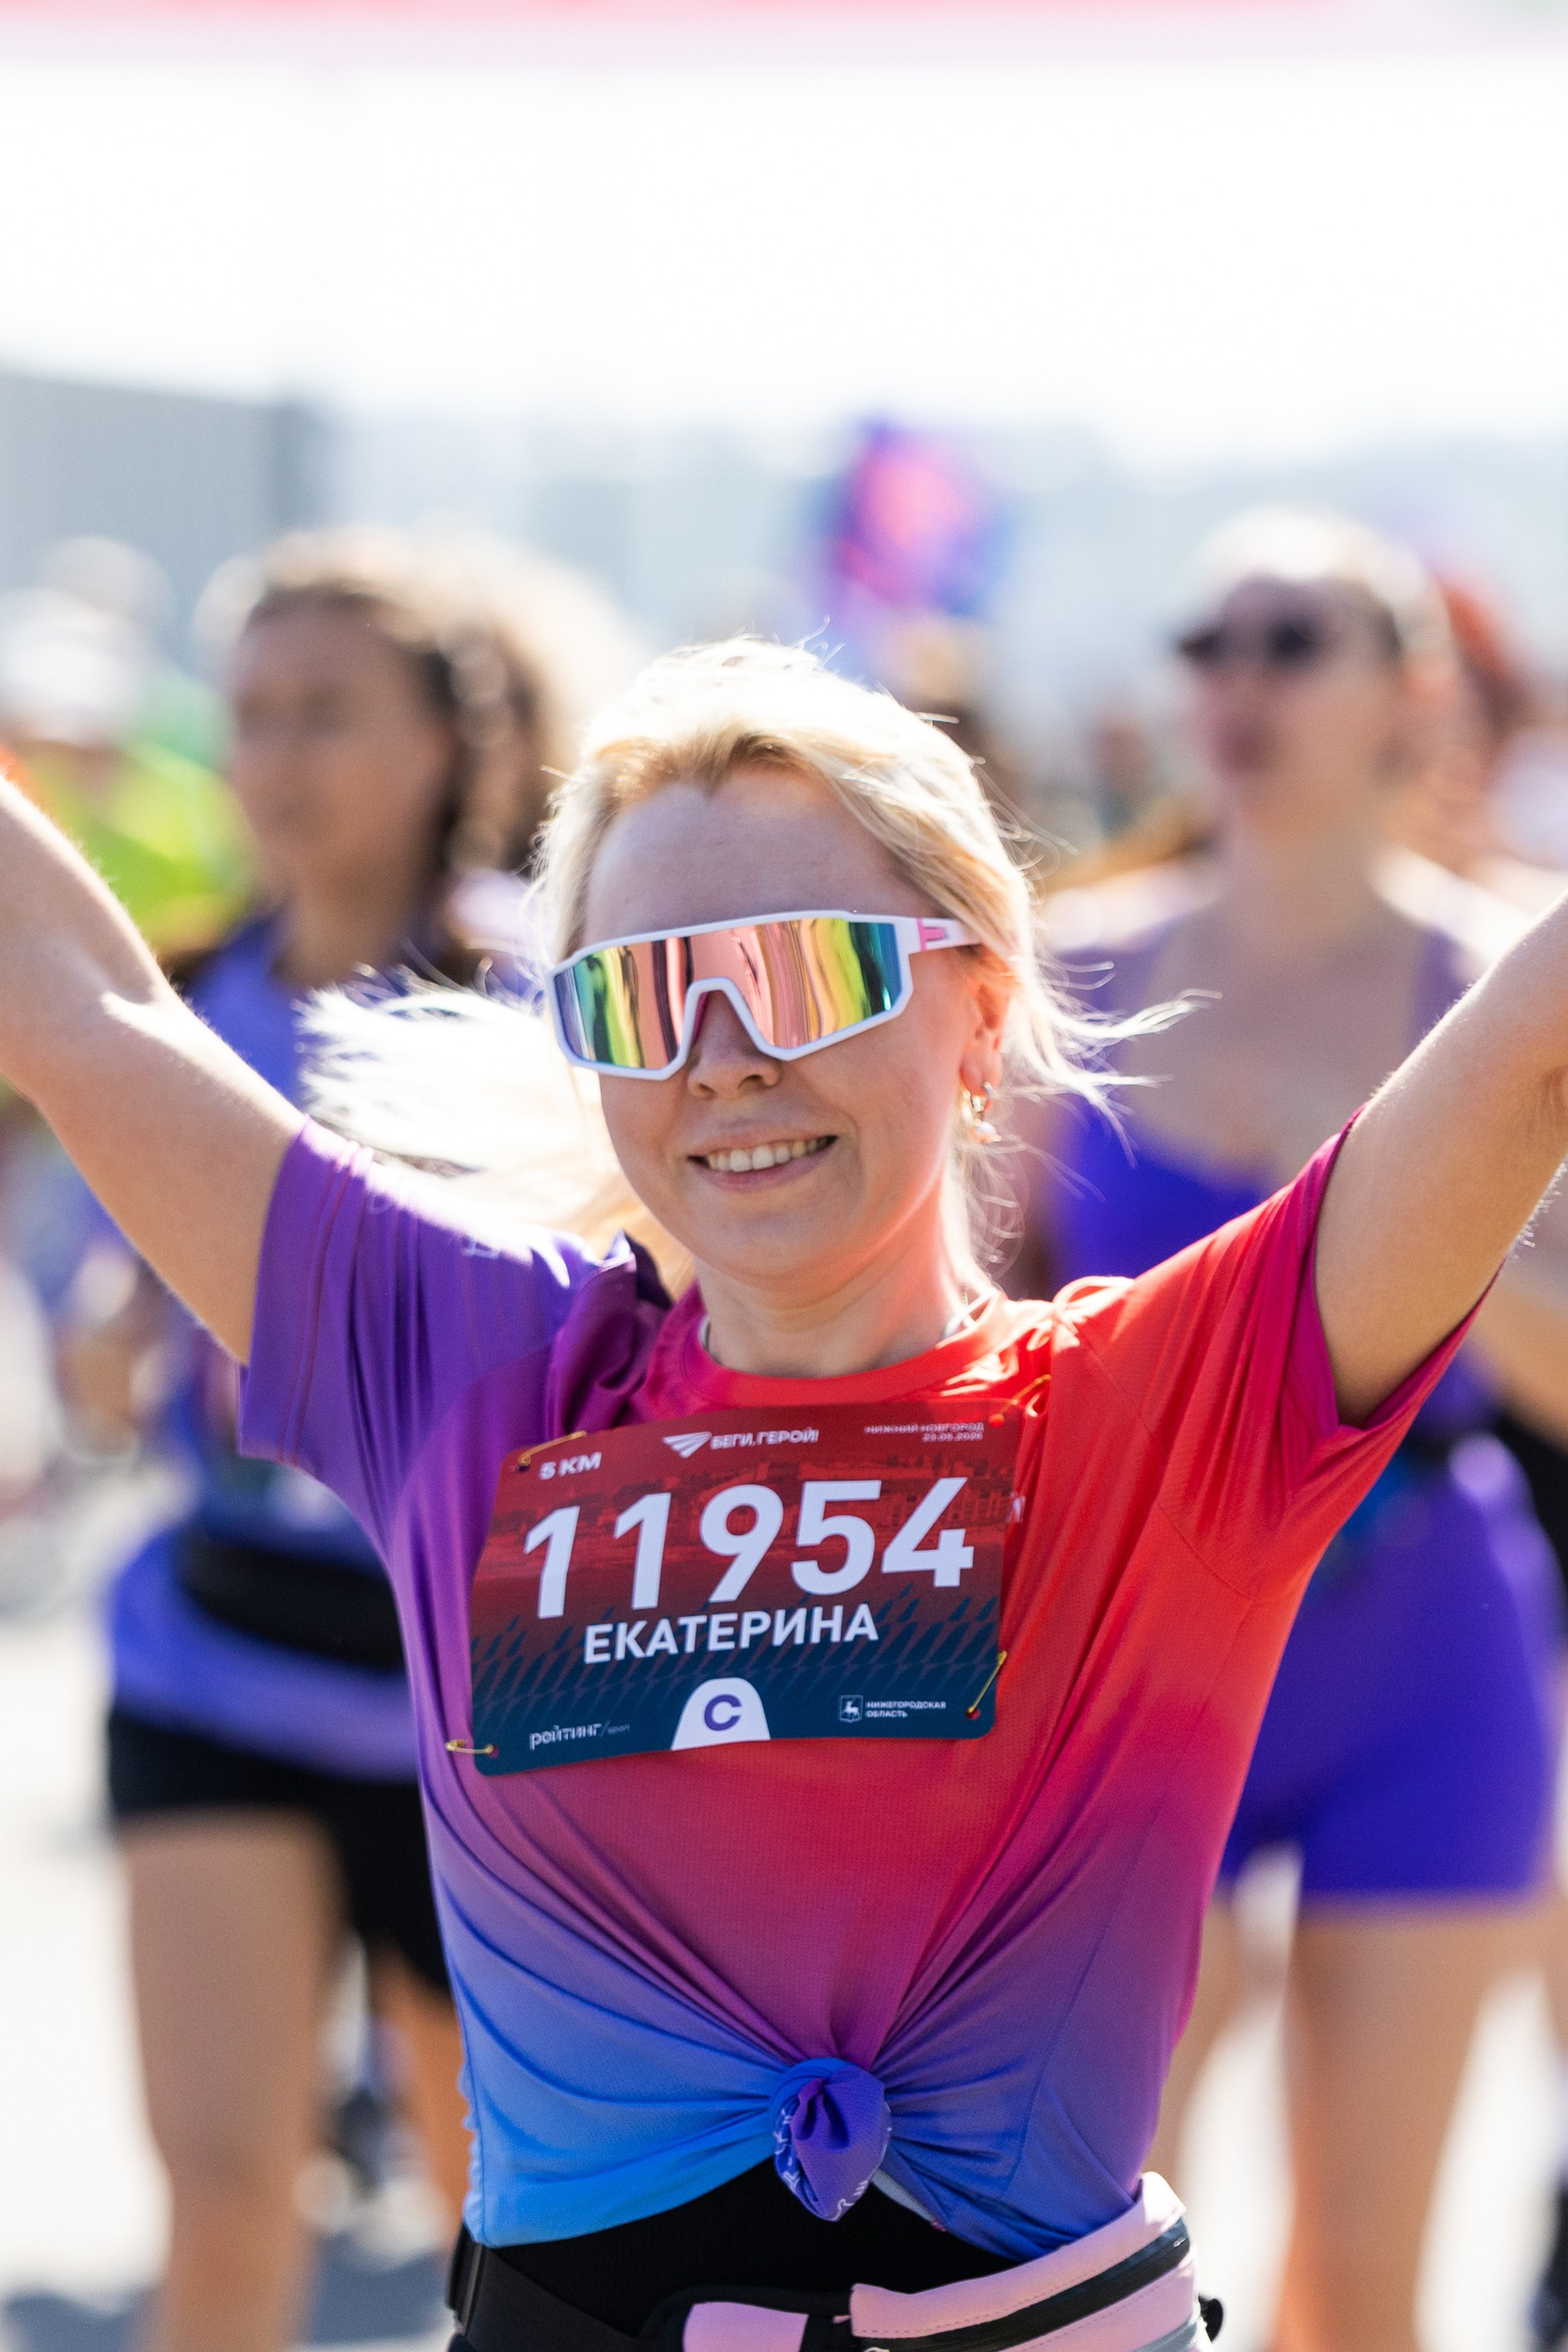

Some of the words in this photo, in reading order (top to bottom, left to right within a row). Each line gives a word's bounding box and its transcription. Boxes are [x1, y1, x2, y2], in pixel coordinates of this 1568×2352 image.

[864, 1422, 918, 1434] НИЖНИЙ
[920, 1422, 984, 1433] НОВГОРОД
[710, 1432, 756, 1450] БЕГИ,
[756, 1427, 820, 1445] ГЕРОЙ!
[539, 1461, 556, 1480] 5
[524, 1477, 974, 1619] 11954
[584, 1604, 879, 1664] ЕКАТЕРИНА
[865, 1700, 947, 1709] НИЖЕГОРОДСКАЯ
[865, 1709, 908, 1718] ОБЛАСТЬ
